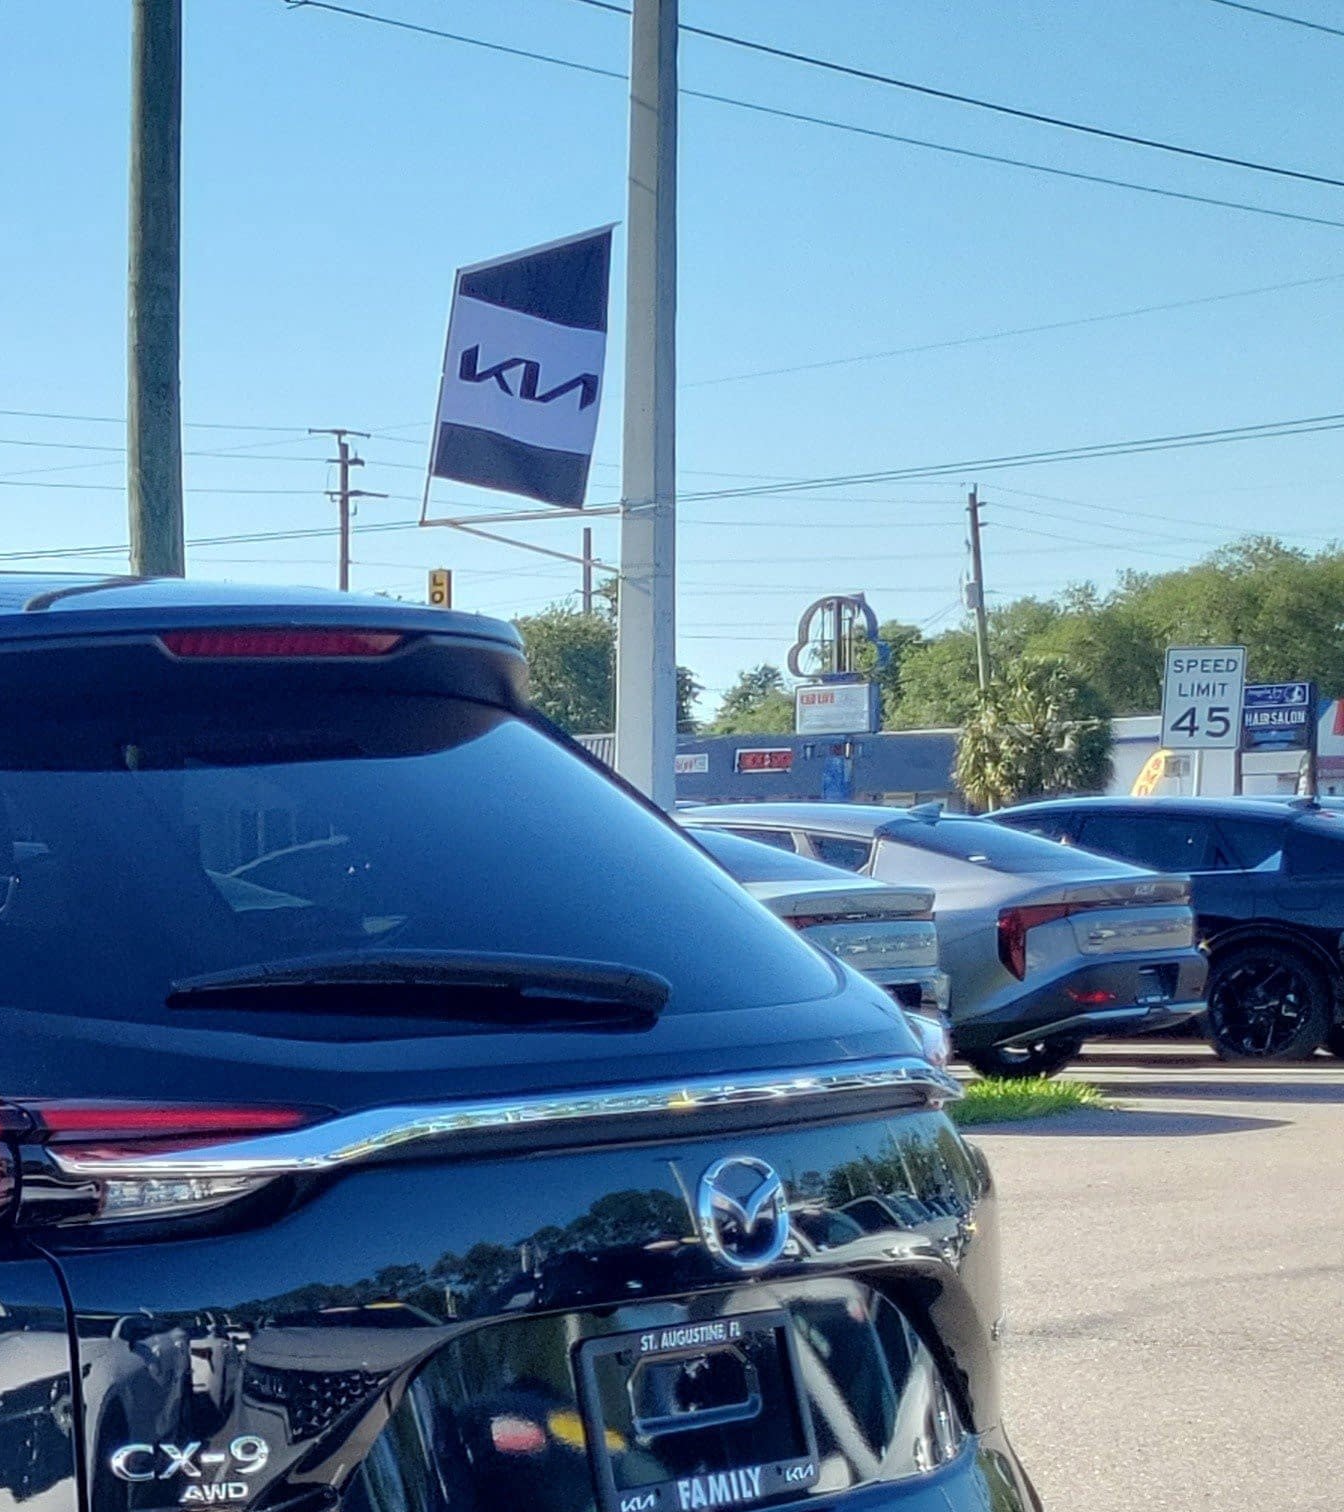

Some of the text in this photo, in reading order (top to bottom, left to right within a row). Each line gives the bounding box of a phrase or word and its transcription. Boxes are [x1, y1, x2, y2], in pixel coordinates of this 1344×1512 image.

[458, 344, 600, 411] KIA
[1173, 658, 1238, 674] SPEED
[1178, 682, 1229, 698] LIMIT
[1170, 706, 1231, 738] 45
[640, 1322, 741, 1352] ST. AUGUSTINE, FL
[111, 1435, 269, 1482] CX-9
[178, 1481, 249, 1504] AWD
[678, 1466, 763, 1510] FAMILY
